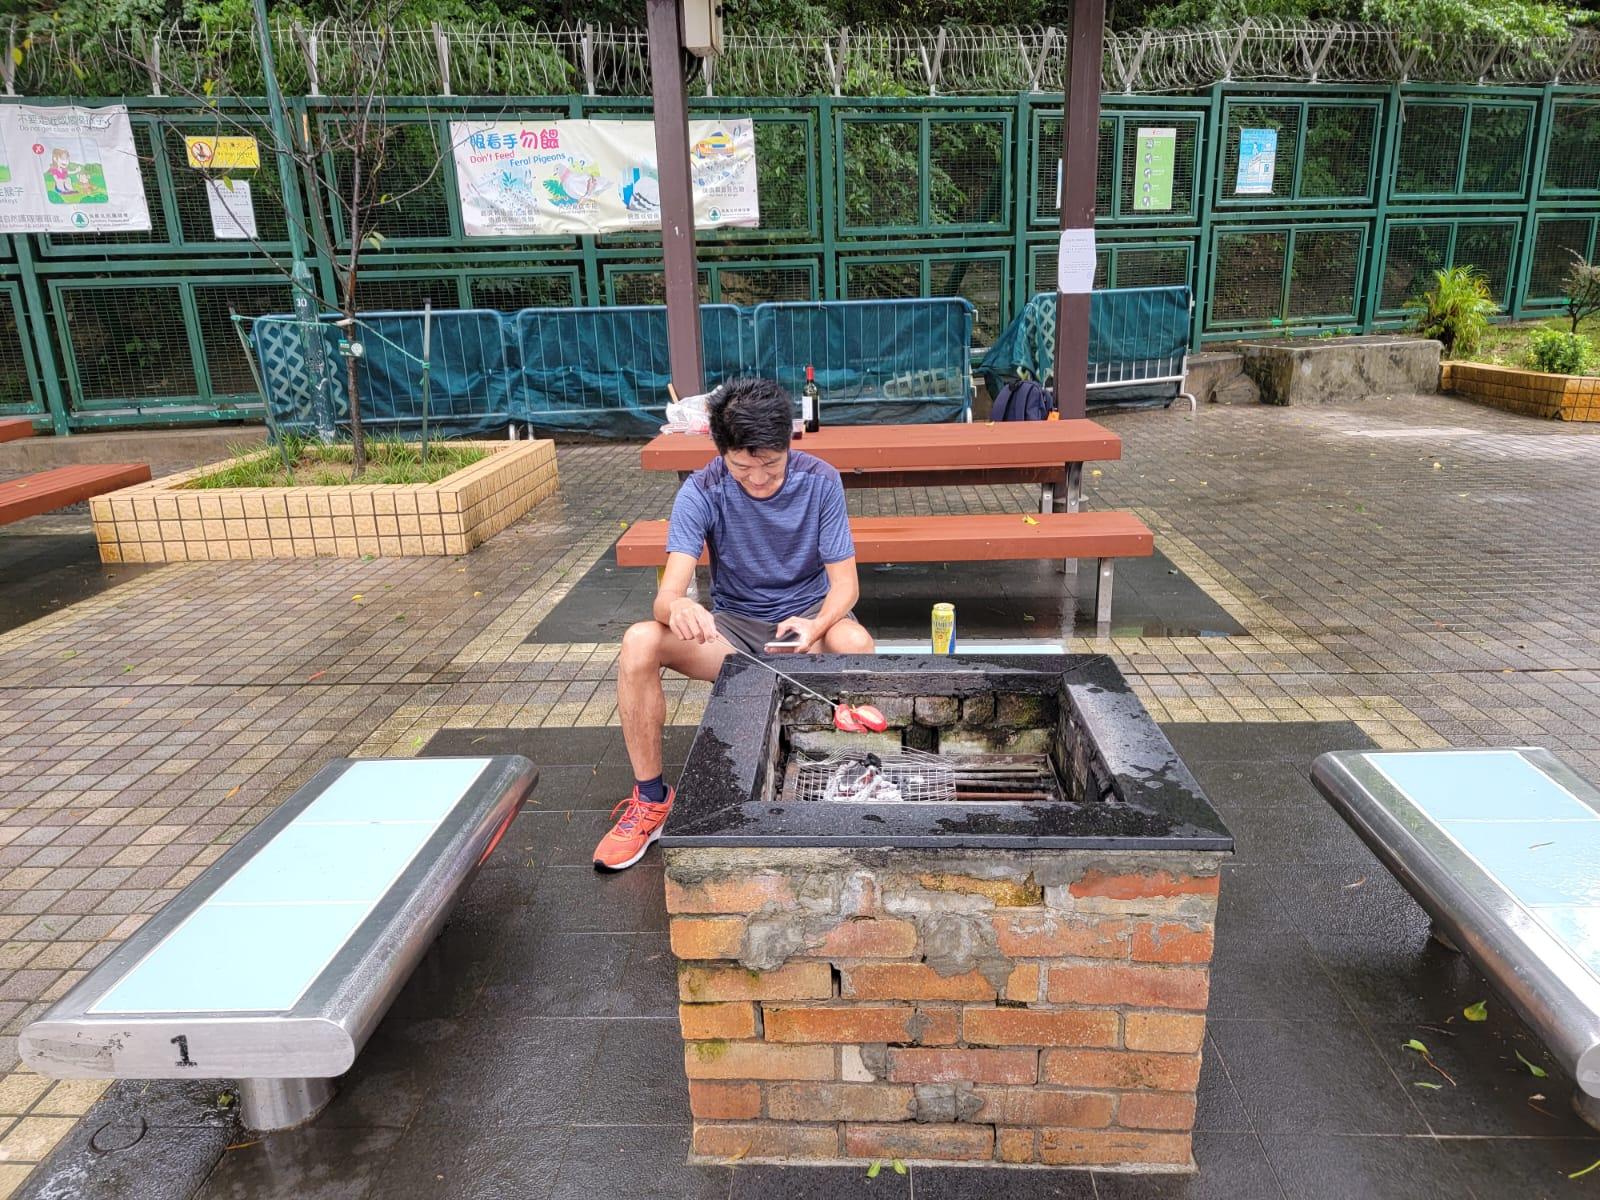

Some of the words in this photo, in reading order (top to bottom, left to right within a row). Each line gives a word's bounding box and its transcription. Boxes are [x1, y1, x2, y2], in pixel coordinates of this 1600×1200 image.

[470, 153, 492, 164] Don't
[495, 150, 515, 161] Feed
[509, 156, 531, 167] Feral
[533, 152, 566, 164] Pigeons
[170, 1034, 198, 1067] 1
